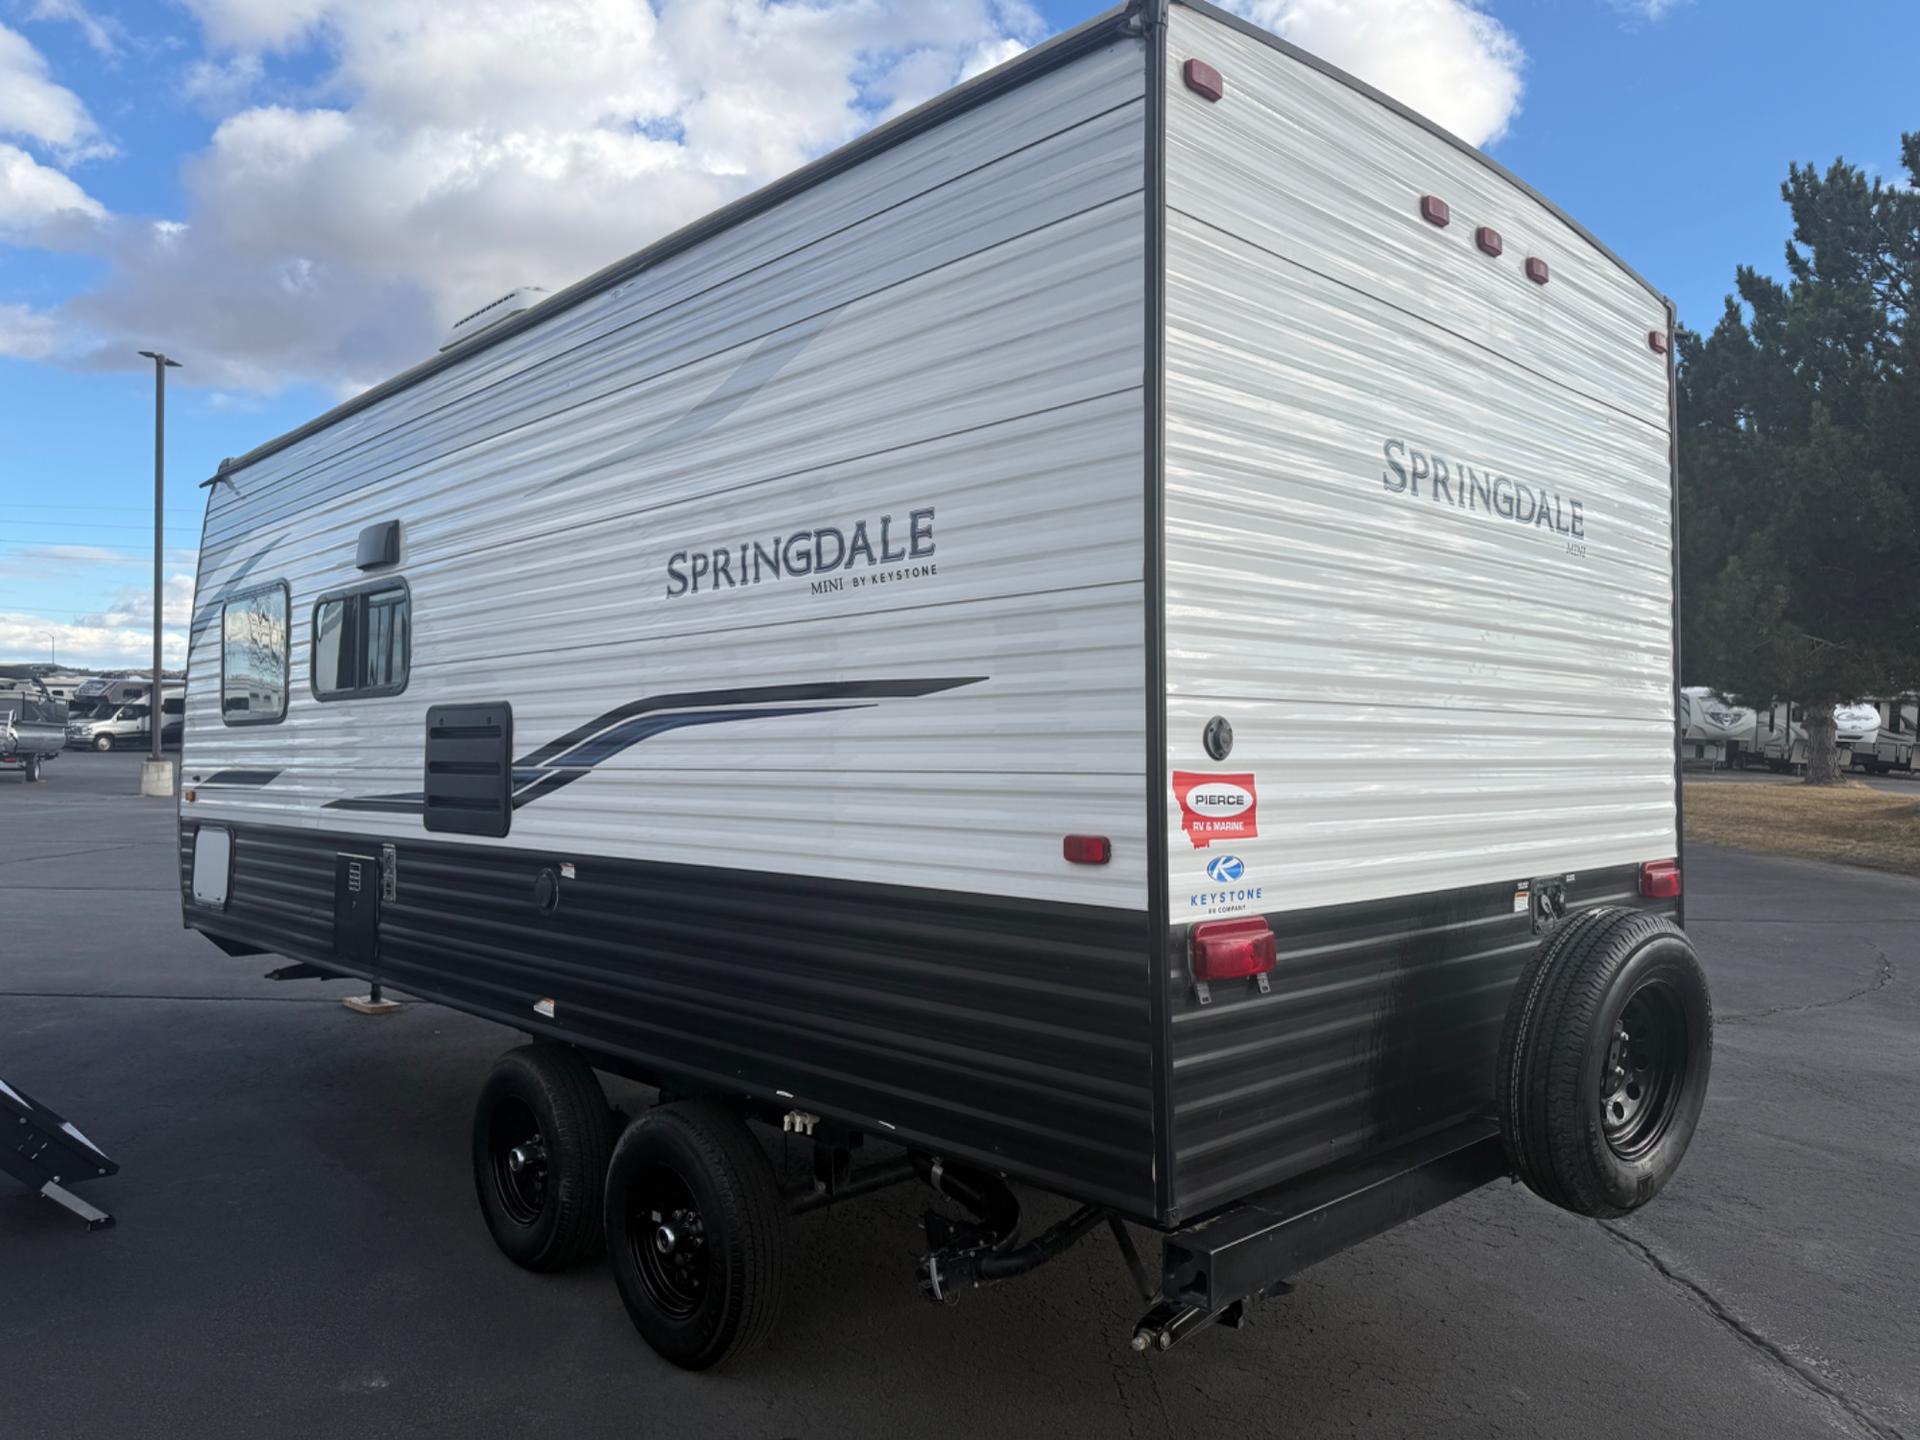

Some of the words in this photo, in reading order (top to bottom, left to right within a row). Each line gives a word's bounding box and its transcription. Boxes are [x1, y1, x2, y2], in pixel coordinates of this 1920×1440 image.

[1383, 438, 1585, 540] SPRINGDALE
[666, 506, 936, 599] SPRINGDALE
[811, 577, 844, 595] MINI
[852, 576, 866, 588] BY
[871, 564, 937, 585] KEYSTONE
[1195, 794, 1245, 806] PIERCE
[1193, 821, 1205, 832] RV
[1213, 821, 1245, 831] MARINE
[1190, 888, 1262, 906] KEYSTONE
[1217, 904, 1246, 914] COMPANY
